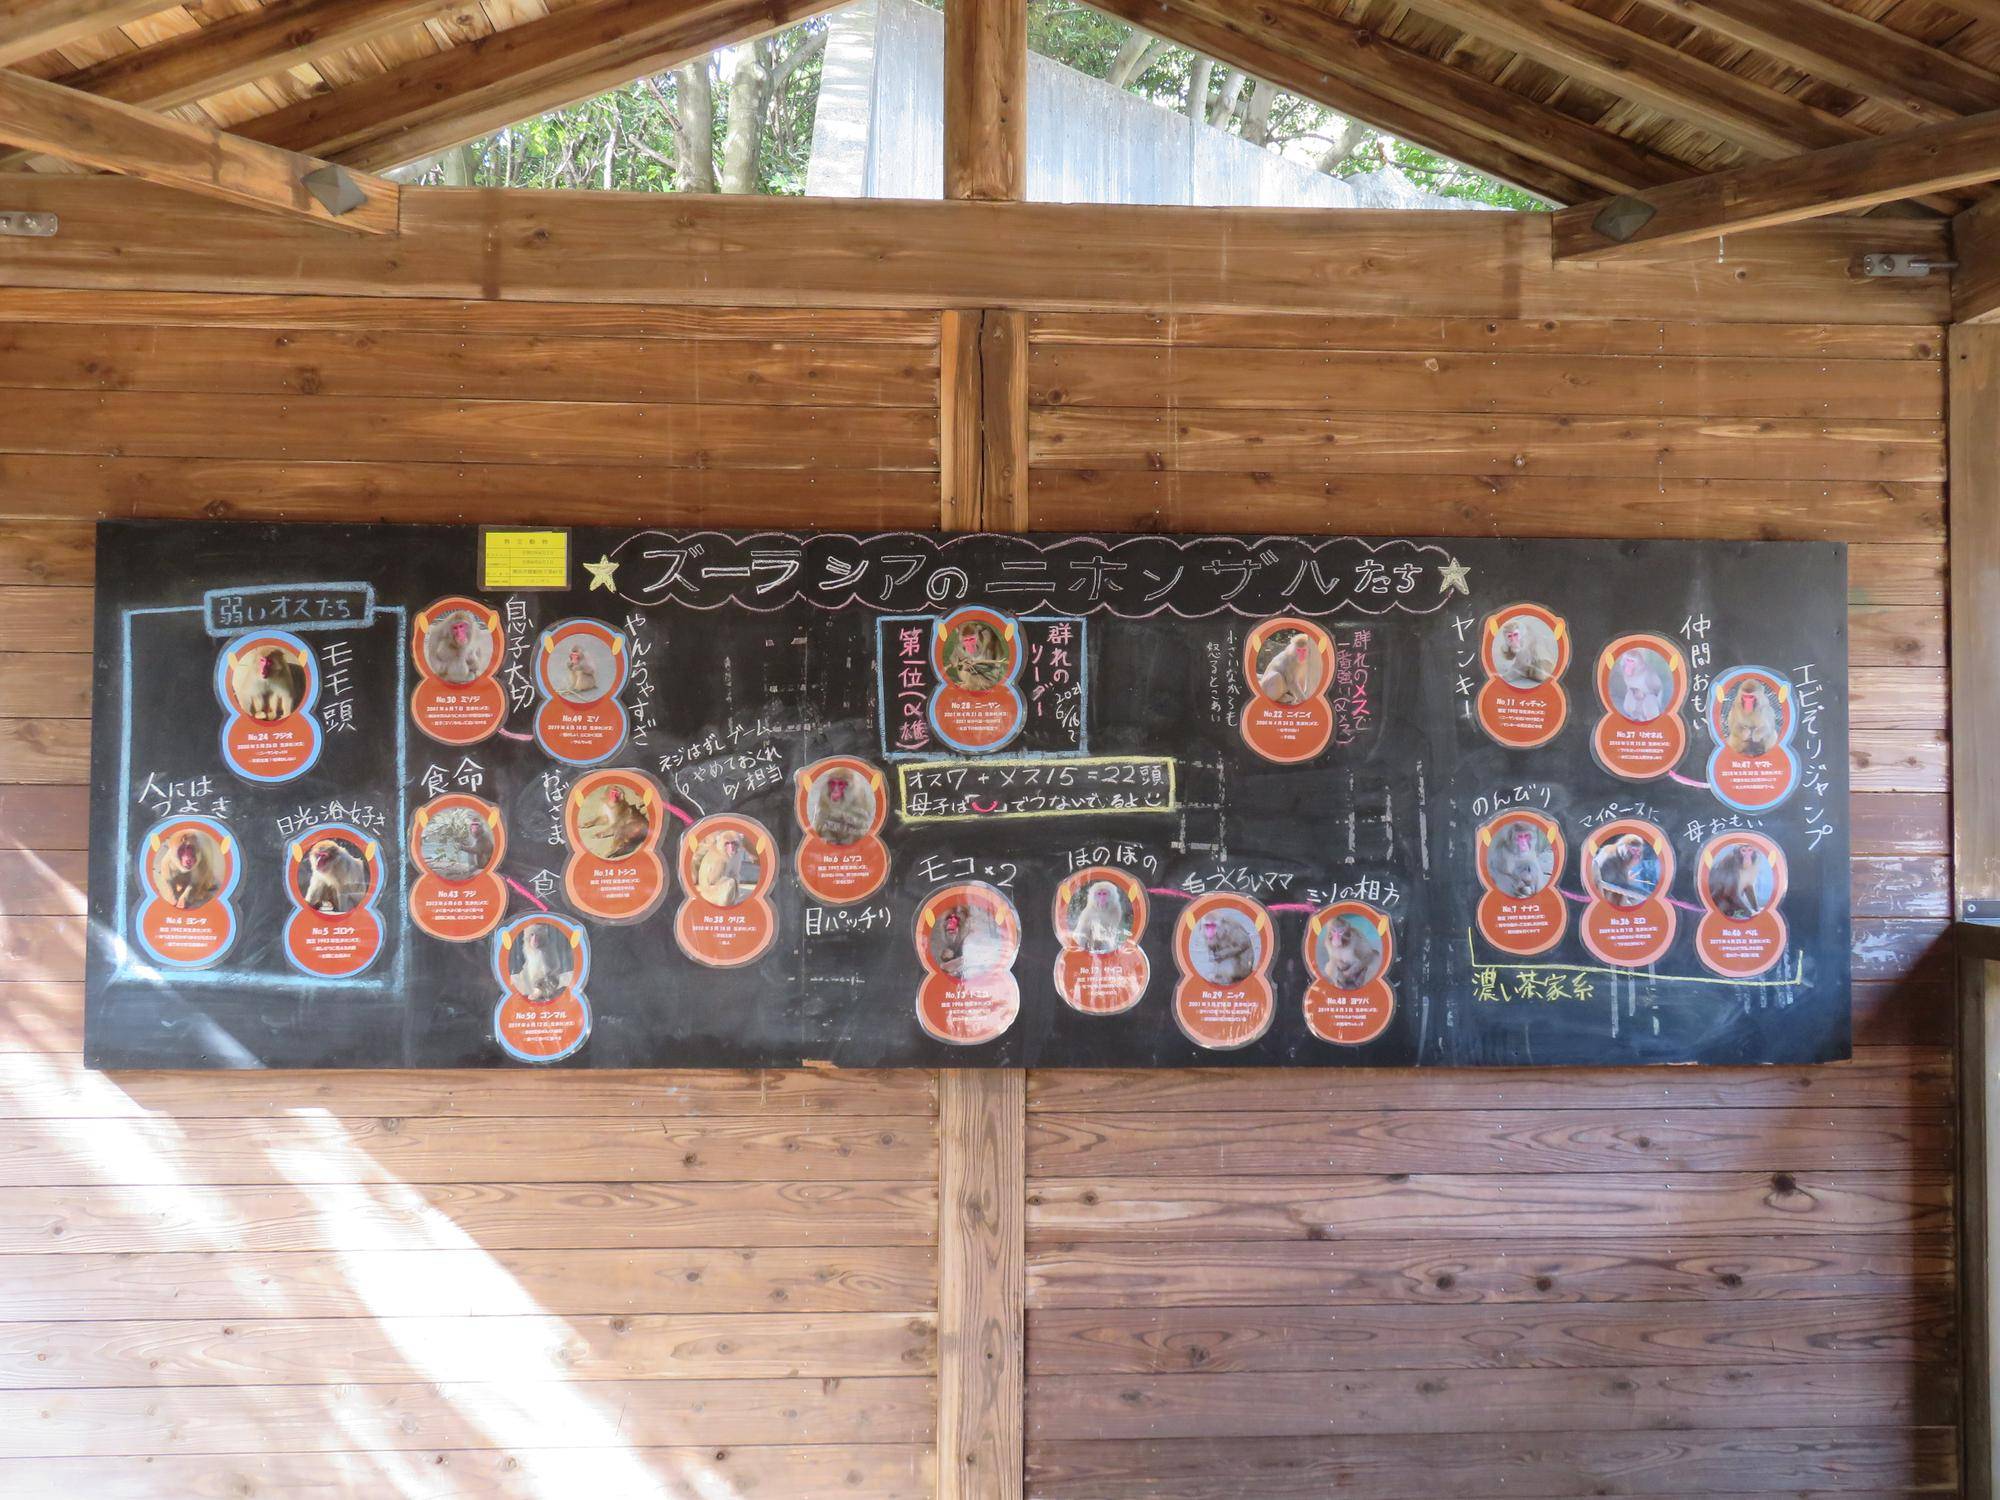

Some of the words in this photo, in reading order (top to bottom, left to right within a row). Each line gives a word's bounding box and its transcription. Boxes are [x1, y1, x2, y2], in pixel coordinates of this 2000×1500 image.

[643, 543, 1423, 601] ズーラシアのニホンザルたち
[220, 596, 350, 625] 弱いオスたち
[504, 597, 535, 713] 息子大切
[1047, 623, 1074, 684] 群れの
[1452, 616, 1475, 719] ヤンキー
[321, 641, 357, 733] モモ頭
[1031, 643, 1054, 717] リーダー
[1352, 629, 1372, 731] 群れのメスで
[1680, 614, 1711, 730] 仲間おもい
[1263, 710, 1282, 718] No.22
[1496, 698, 1515, 706] No.11
[694, 747, 782, 782] やめておくれ
[1793, 664, 1833, 850] エビぞりジャンプ
[138, 772, 214, 803] 人には
[420, 757, 485, 799] 食命
[745, 763, 783, 791] 担当
[541, 769, 570, 845] おばさま
[1472, 784, 1551, 816] のんびり
[276, 801, 385, 836] 日光浴好き
[1684, 815, 1763, 843] 母おもい
[594, 869, 614, 877] No.14
[1069, 844, 1157, 875] ほのぼの
[529, 869, 561, 900] 食
[1183, 867, 1294, 894] 毛づくろいママ
[1307, 875, 1400, 905] ミソの相方
[312, 927, 329, 935] No.5
[806, 905, 891, 935] 目パッチリ
[1472, 967, 1594, 1001] 濃い茶家系
